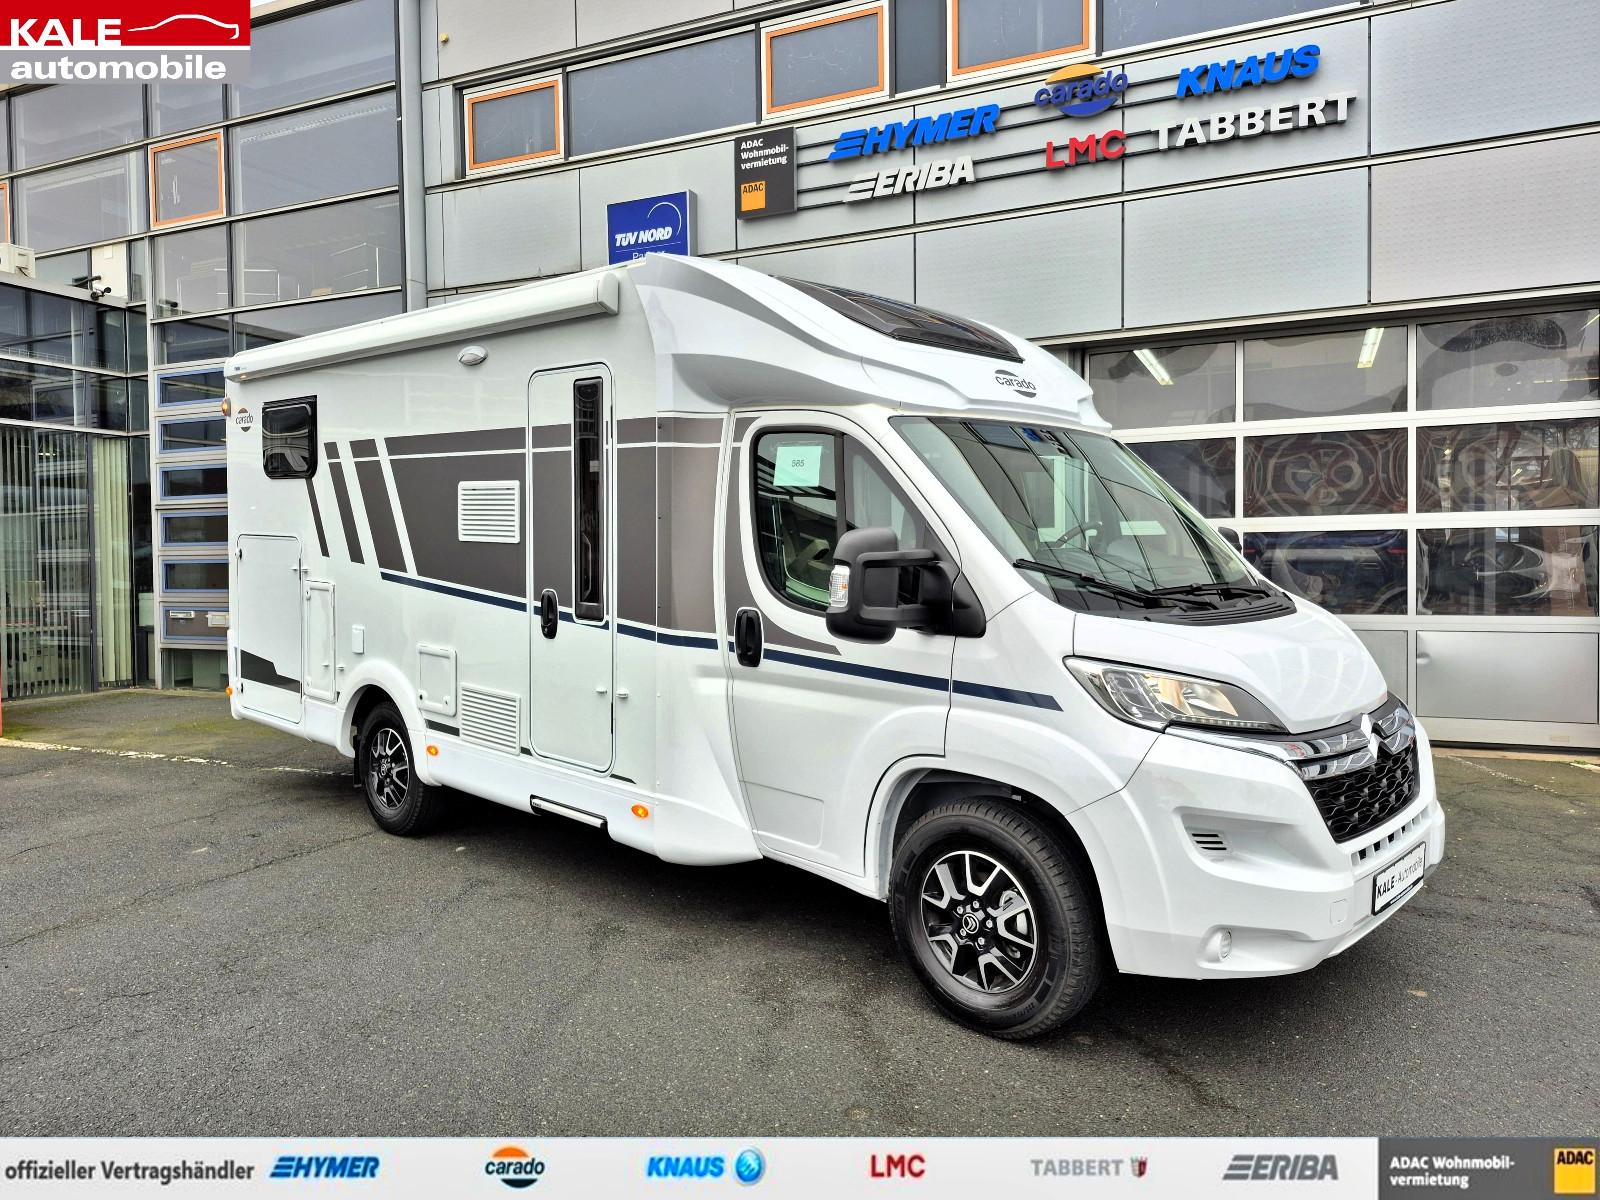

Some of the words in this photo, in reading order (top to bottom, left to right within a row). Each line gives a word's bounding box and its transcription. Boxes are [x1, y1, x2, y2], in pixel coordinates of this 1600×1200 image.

[1176, 45, 1321, 97] KNAUS
[1033, 70, 1129, 108] carado
[861, 103, 1001, 156] HYMER
[1152, 91, 1357, 151] TABBERT
[740, 138, 764, 150] ADAC
[740, 143, 790, 160] Wohnmobil-
[1045, 129, 1128, 169] LMC
[740, 155, 788, 170] vermietung
[874, 155, 975, 198] ERIBA
[742, 182, 764, 195] ADAC
[614, 232, 639, 247] TÜV
[637, 226, 673, 244] NORD
[994, 375, 1037, 391] carado
[235, 412, 254, 425] carado
